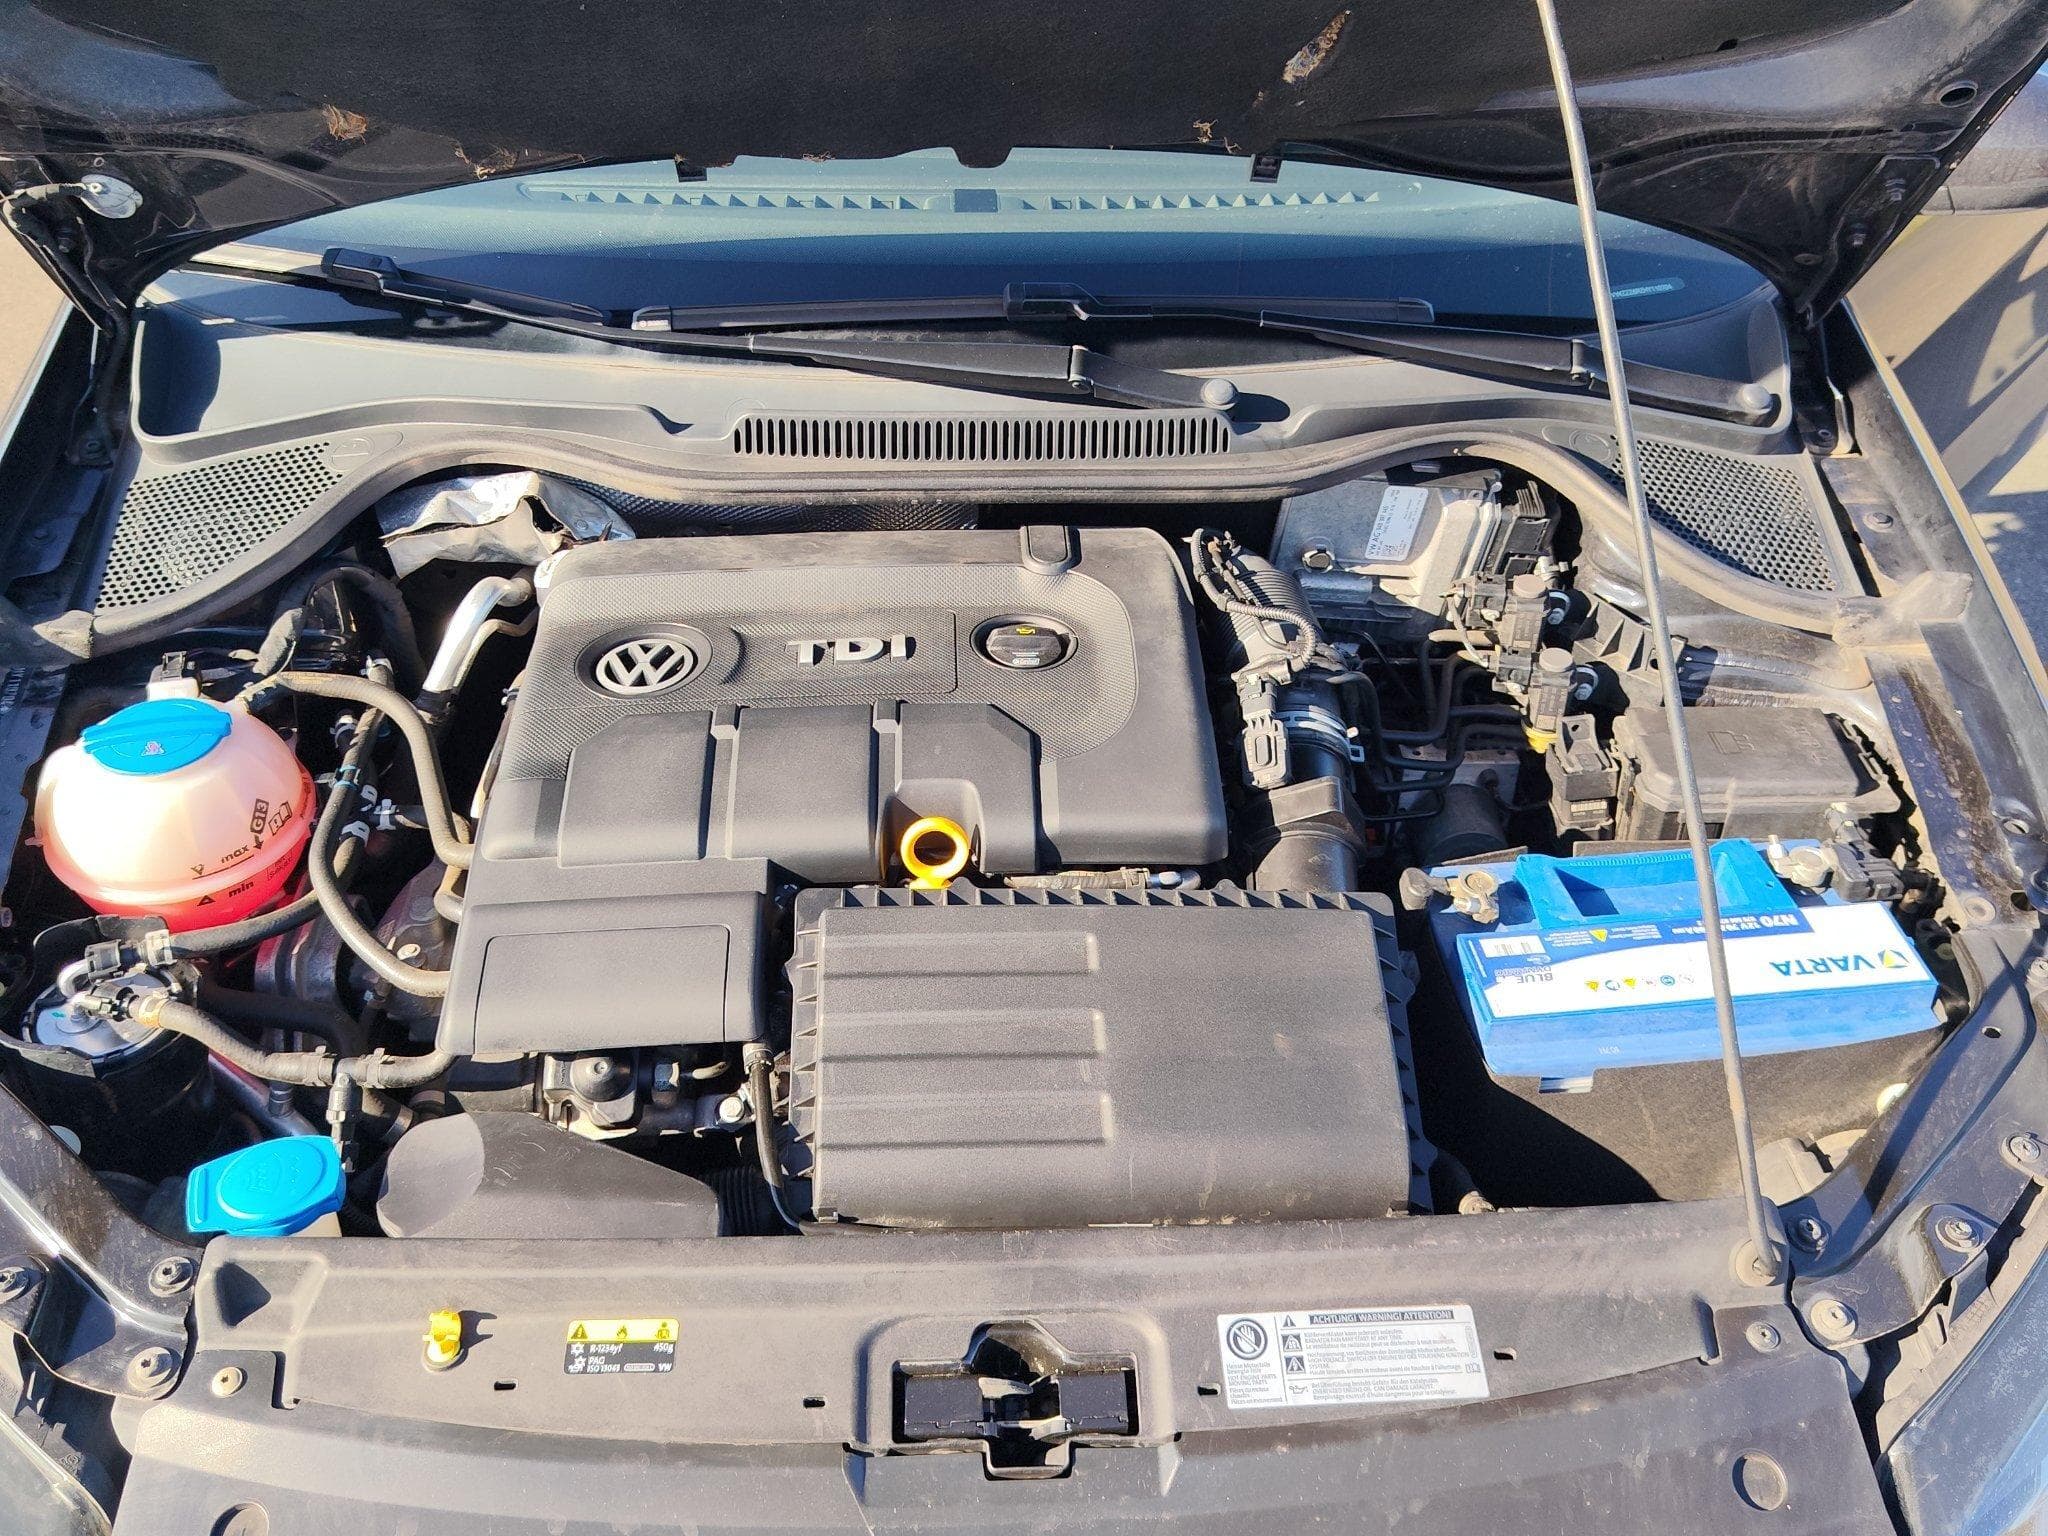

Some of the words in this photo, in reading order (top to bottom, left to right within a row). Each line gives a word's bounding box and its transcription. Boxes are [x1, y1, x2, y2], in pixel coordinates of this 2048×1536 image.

[785, 633, 908, 668] TDI
[251, 801, 268, 832] G13
[221, 845, 250, 863] max
[228, 881, 254, 897] min
[1760, 913, 1799, 928] N70
[1769, 954, 1876, 977] VARTA
[1517, 972, 1553, 984] BLUE
[1313, 1314, 1357, 1324] ACHTUNG!
[1359, 1311, 1400, 1322] WARNING!
[1403, 1309, 1452, 1320] ATTENTION!
